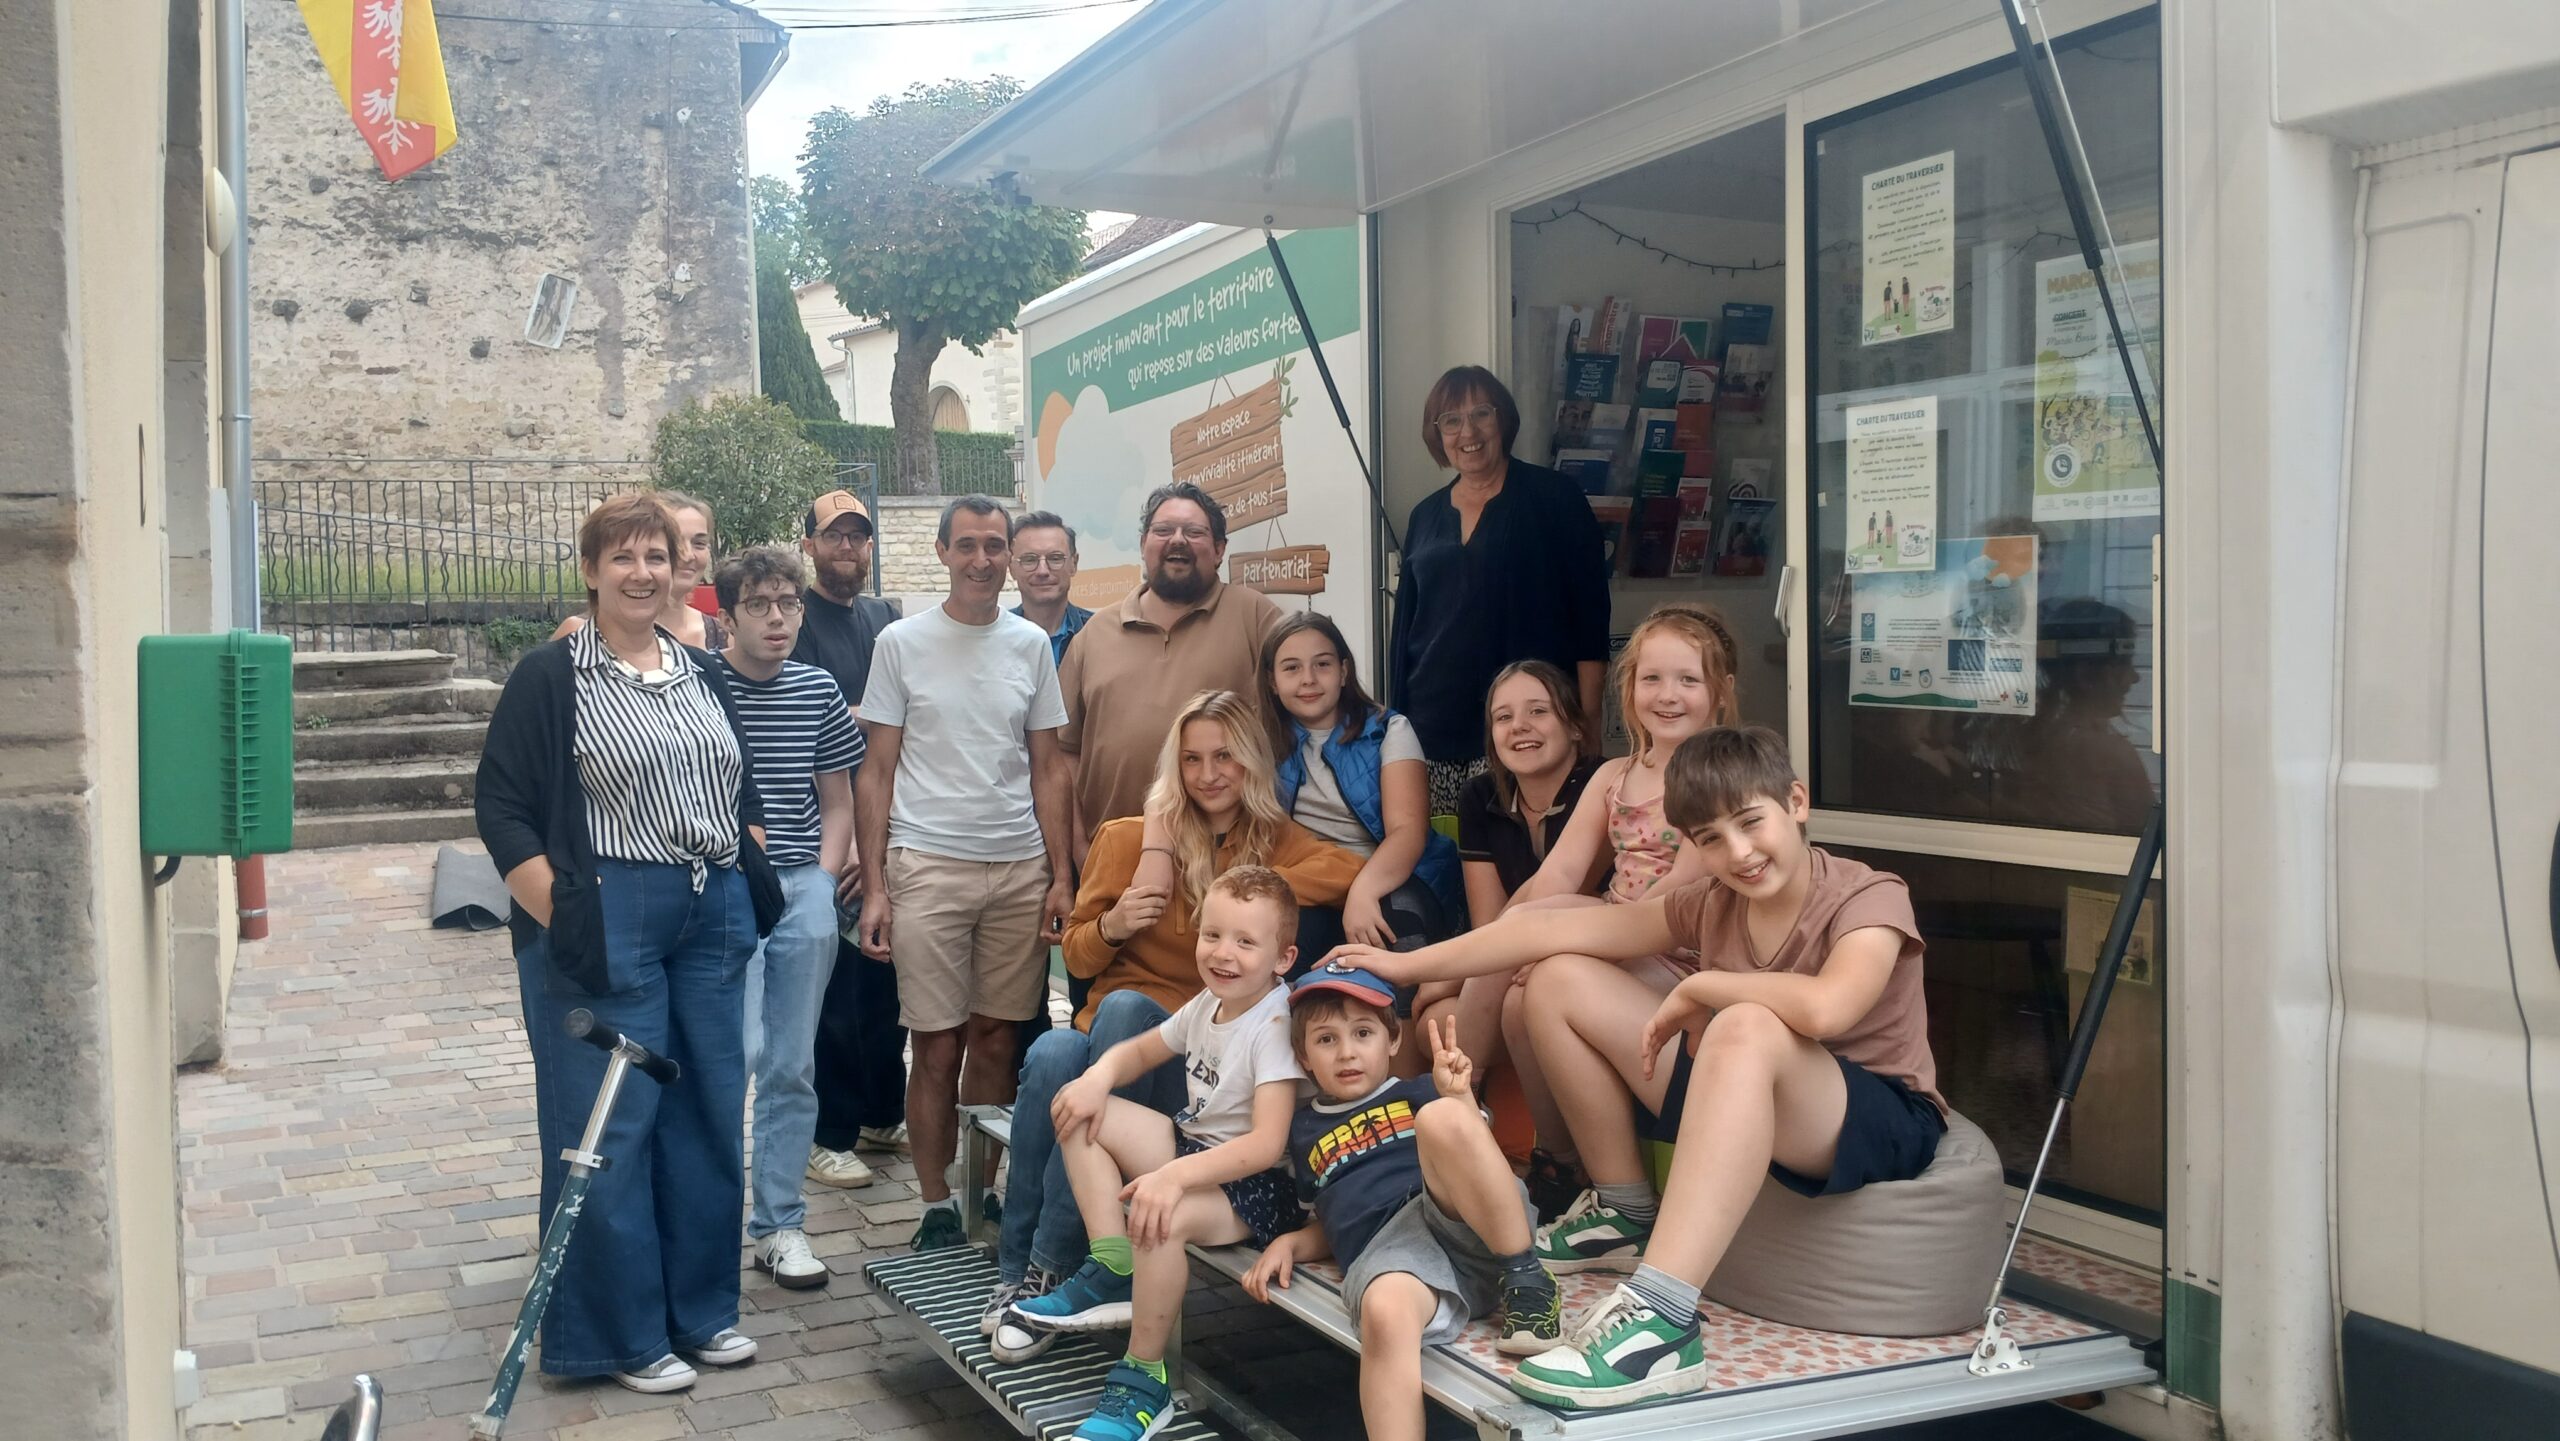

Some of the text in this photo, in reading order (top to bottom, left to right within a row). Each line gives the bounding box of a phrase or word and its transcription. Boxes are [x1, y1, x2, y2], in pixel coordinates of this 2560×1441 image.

[1871, 163, 1944, 191] CHARTE DU TRAVERSIER
[1067, 266, 1274, 378] Un projet innovant pour le territoire
[1128, 312, 1302, 391] qui repose sur des valeurs fortes
[1197, 410, 1250, 447] Notre espace
[1856, 415, 1880, 426] CHARTE
[1888, 410, 1925, 422] TRAVERSIER
[1237, 436, 1279, 474] itinérant
[1235, 496, 1246, 514] de
[1243, 552, 1312, 588] partenariat
